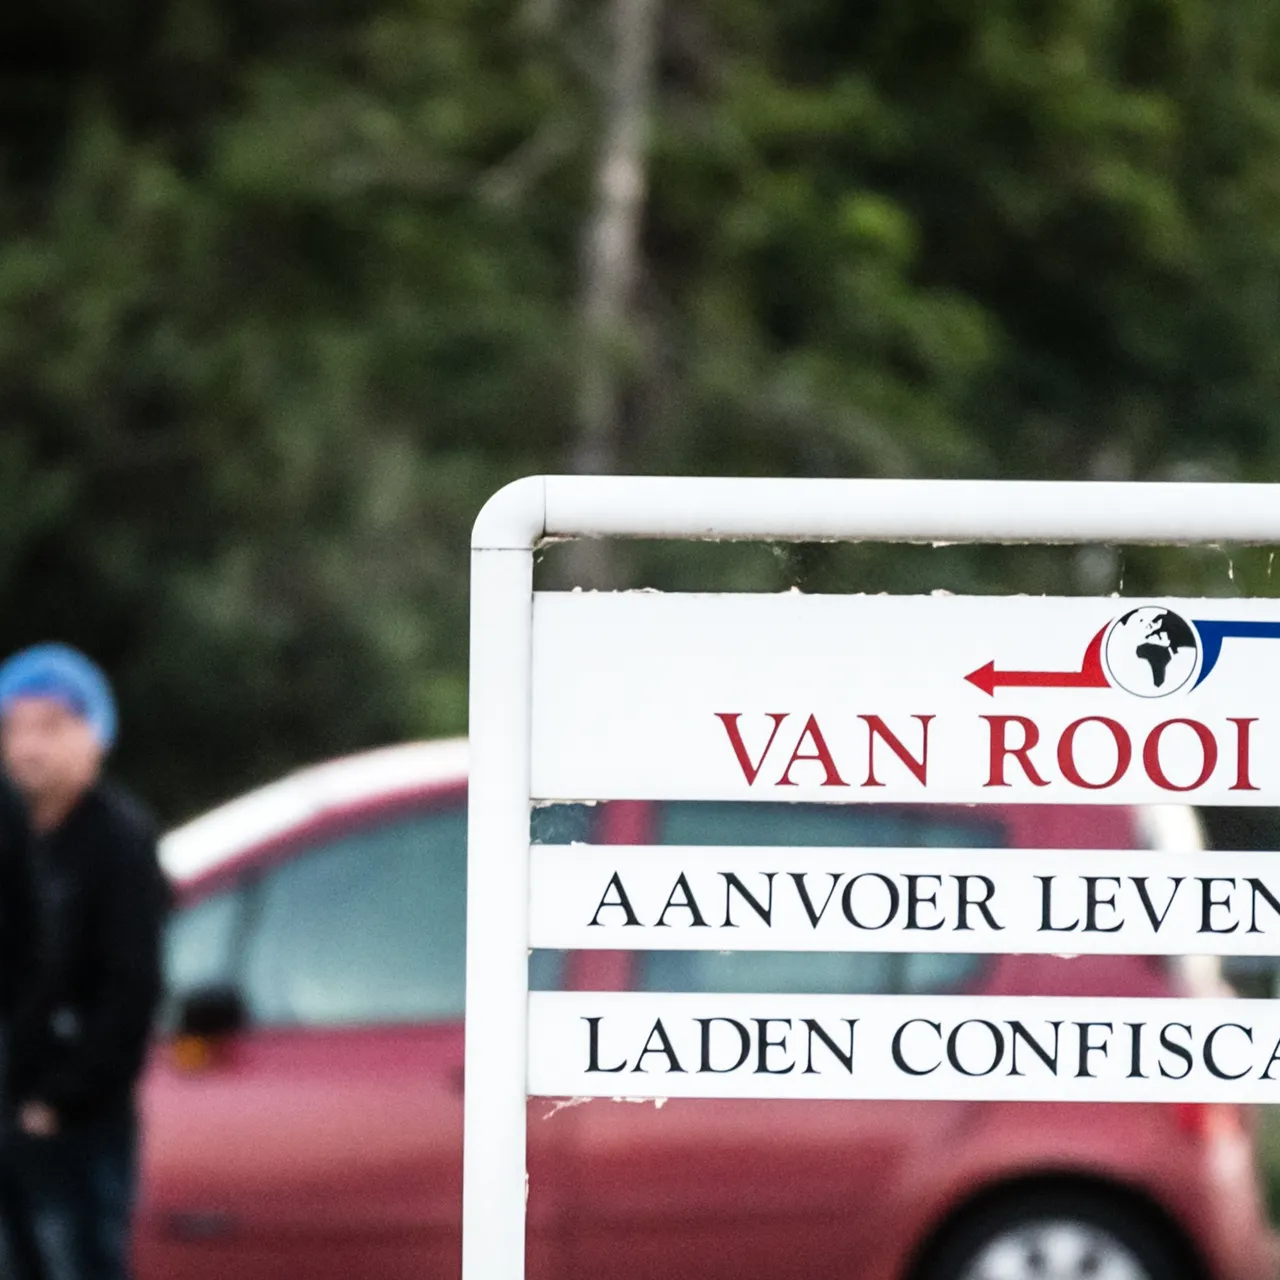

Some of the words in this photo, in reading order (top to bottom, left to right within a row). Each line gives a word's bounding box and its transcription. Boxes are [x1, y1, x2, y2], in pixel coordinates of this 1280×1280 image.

[714, 712, 937, 787] VAN
[978, 714, 1261, 792] ROOI
[587, 871, 1006, 931] AANVOER
[583, 1016, 859, 1075] LADEN
